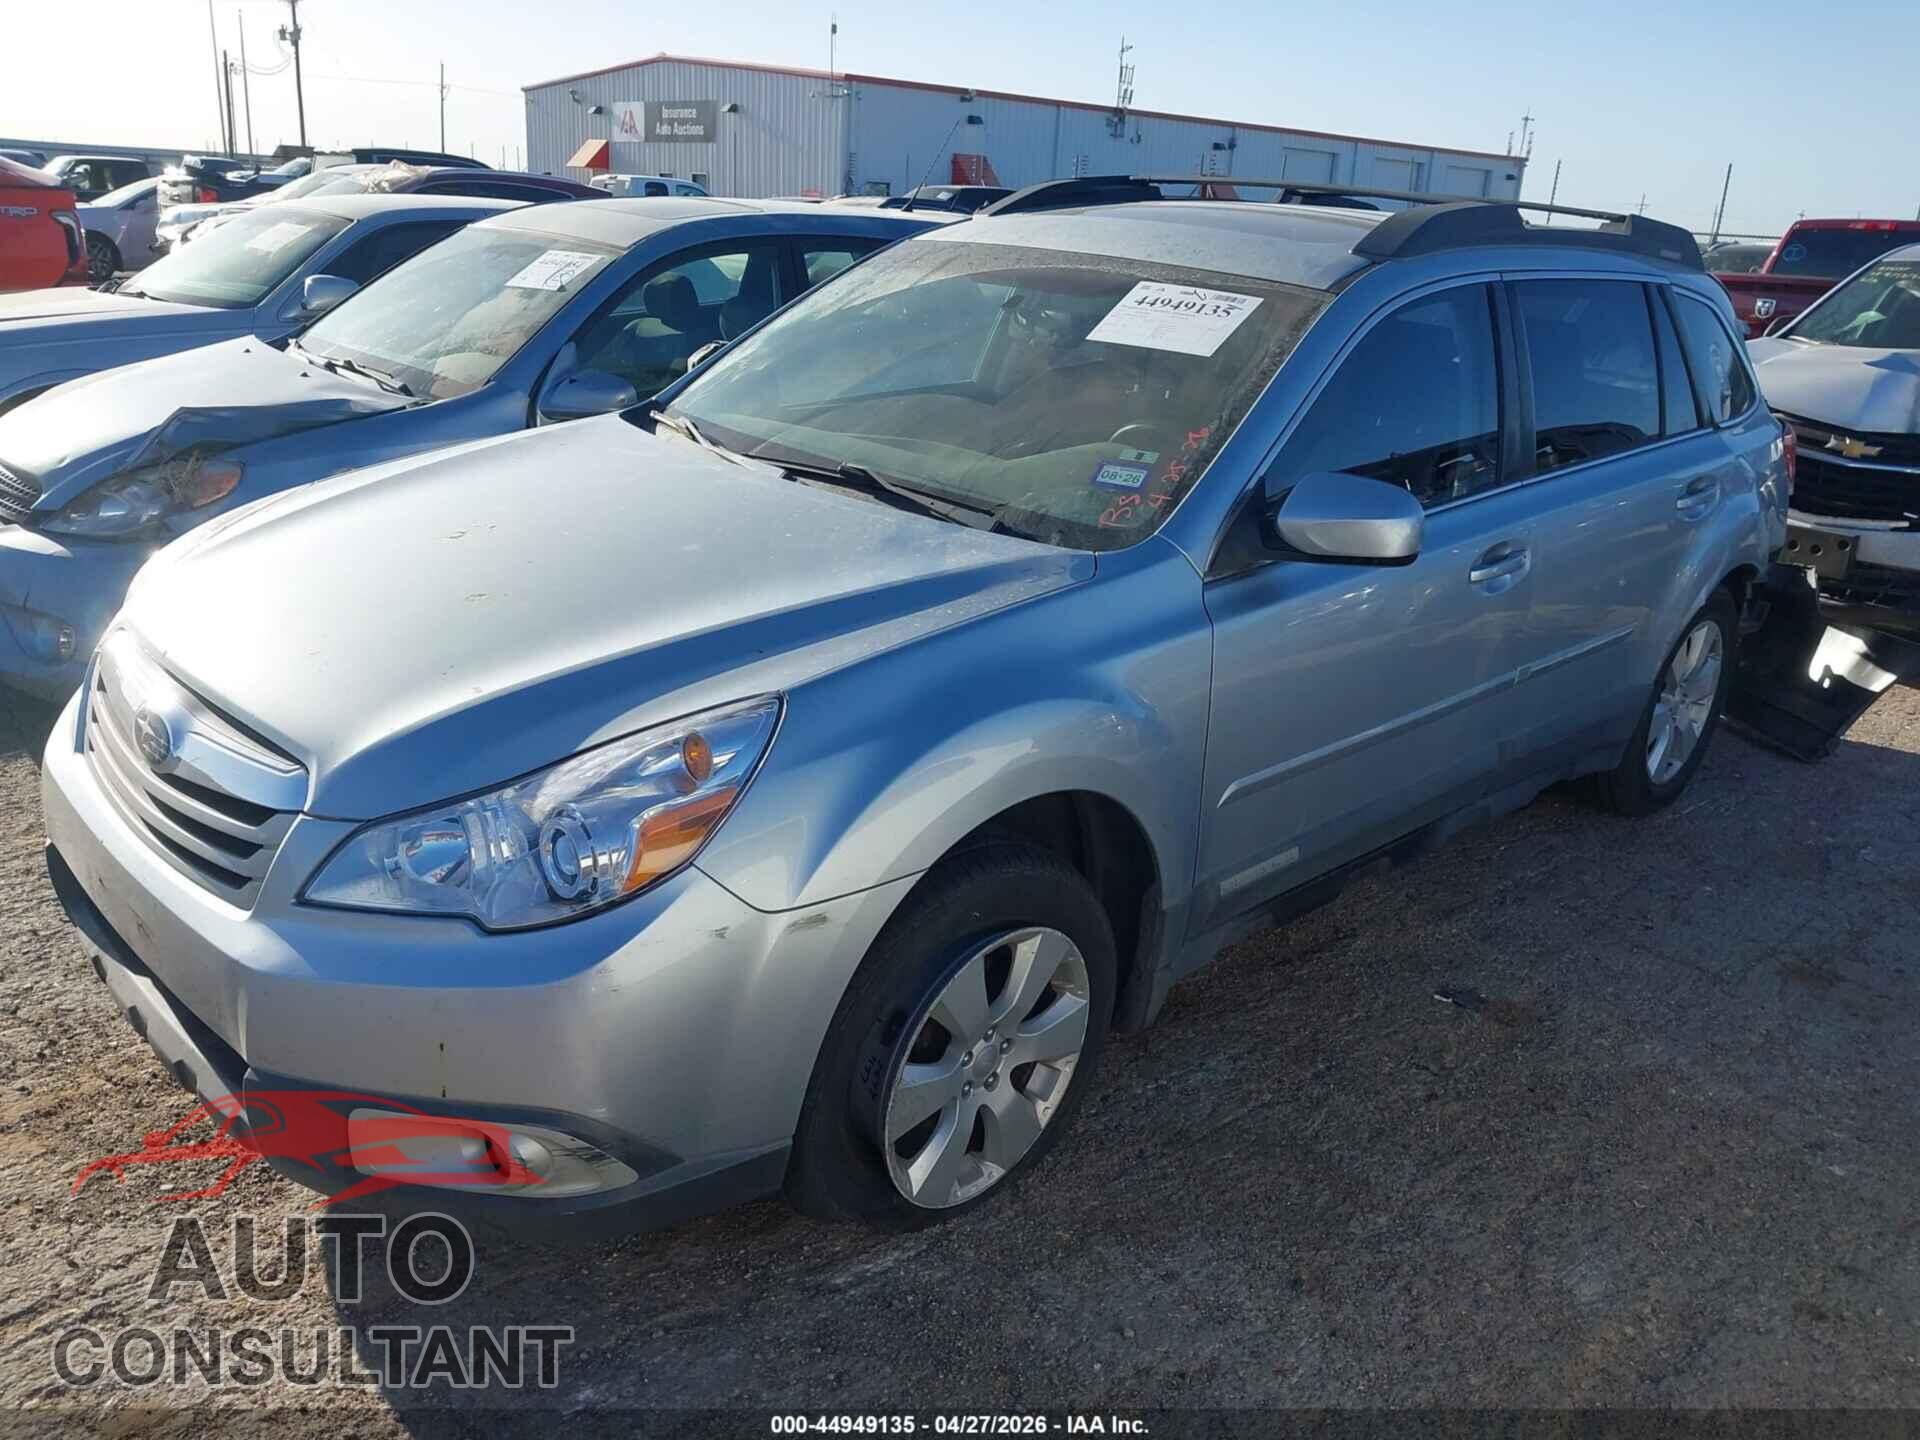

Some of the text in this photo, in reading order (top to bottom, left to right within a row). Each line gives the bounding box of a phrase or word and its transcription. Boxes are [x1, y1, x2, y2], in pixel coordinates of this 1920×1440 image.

[662, 105, 697, 119] Insurance
[655, 122, 671, 136] Auto
[673, 122, 704, 136] Auctions
[1134, 295, 1232, 318] 44949135
